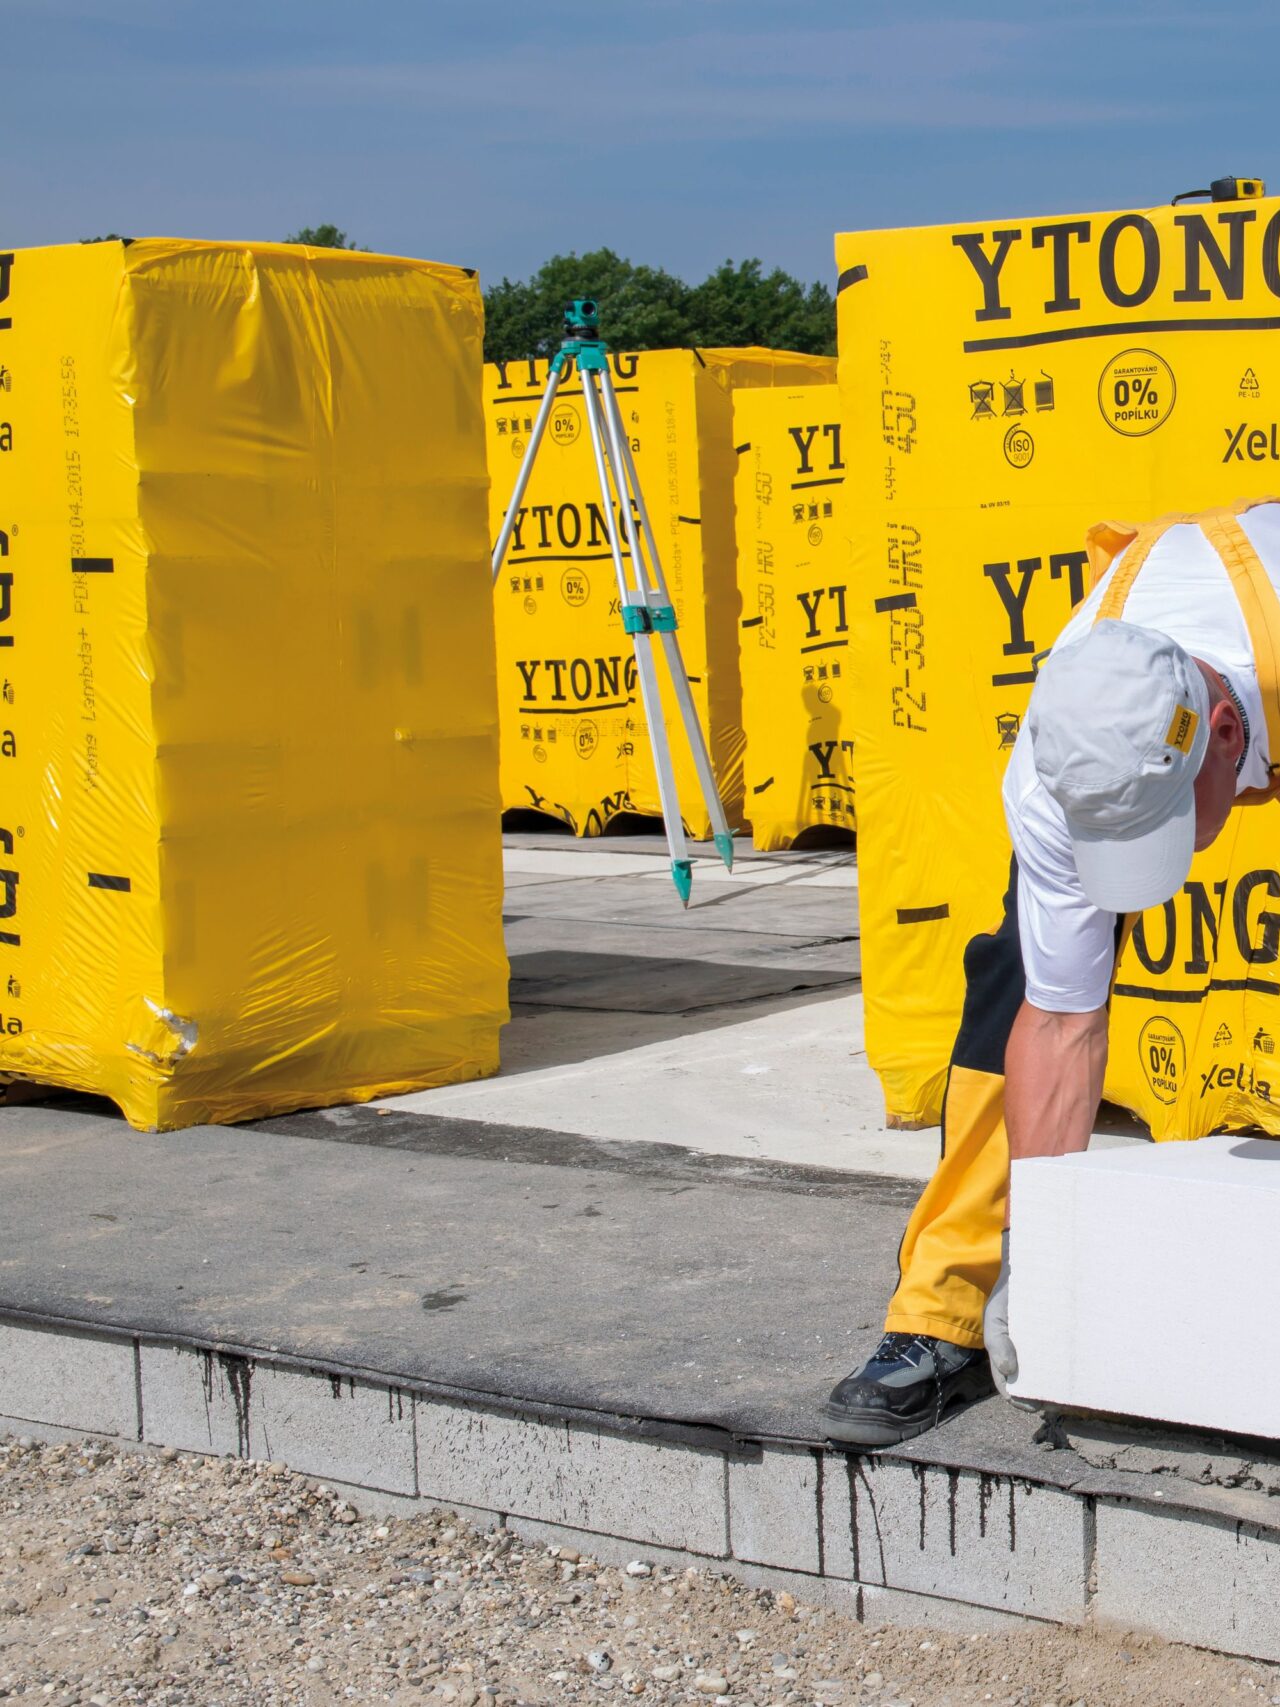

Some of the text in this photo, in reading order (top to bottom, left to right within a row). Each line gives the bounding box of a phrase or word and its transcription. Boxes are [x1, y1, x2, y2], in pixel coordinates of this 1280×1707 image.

[1113, 365, 1158, 375] GARANTOVÁNO
[1114, 378, 1158, 407] 0%
[1114, 407, 1159, 422] POPÍLKU
[555, 418, 574, 433] 0%
[1013, 438, 1030, 452] ISO
[566, 581, 584, 595] 0%
[1174, 711, 1190, 746] YTONG
[1149, 1045, 1176, 1078] 0%
